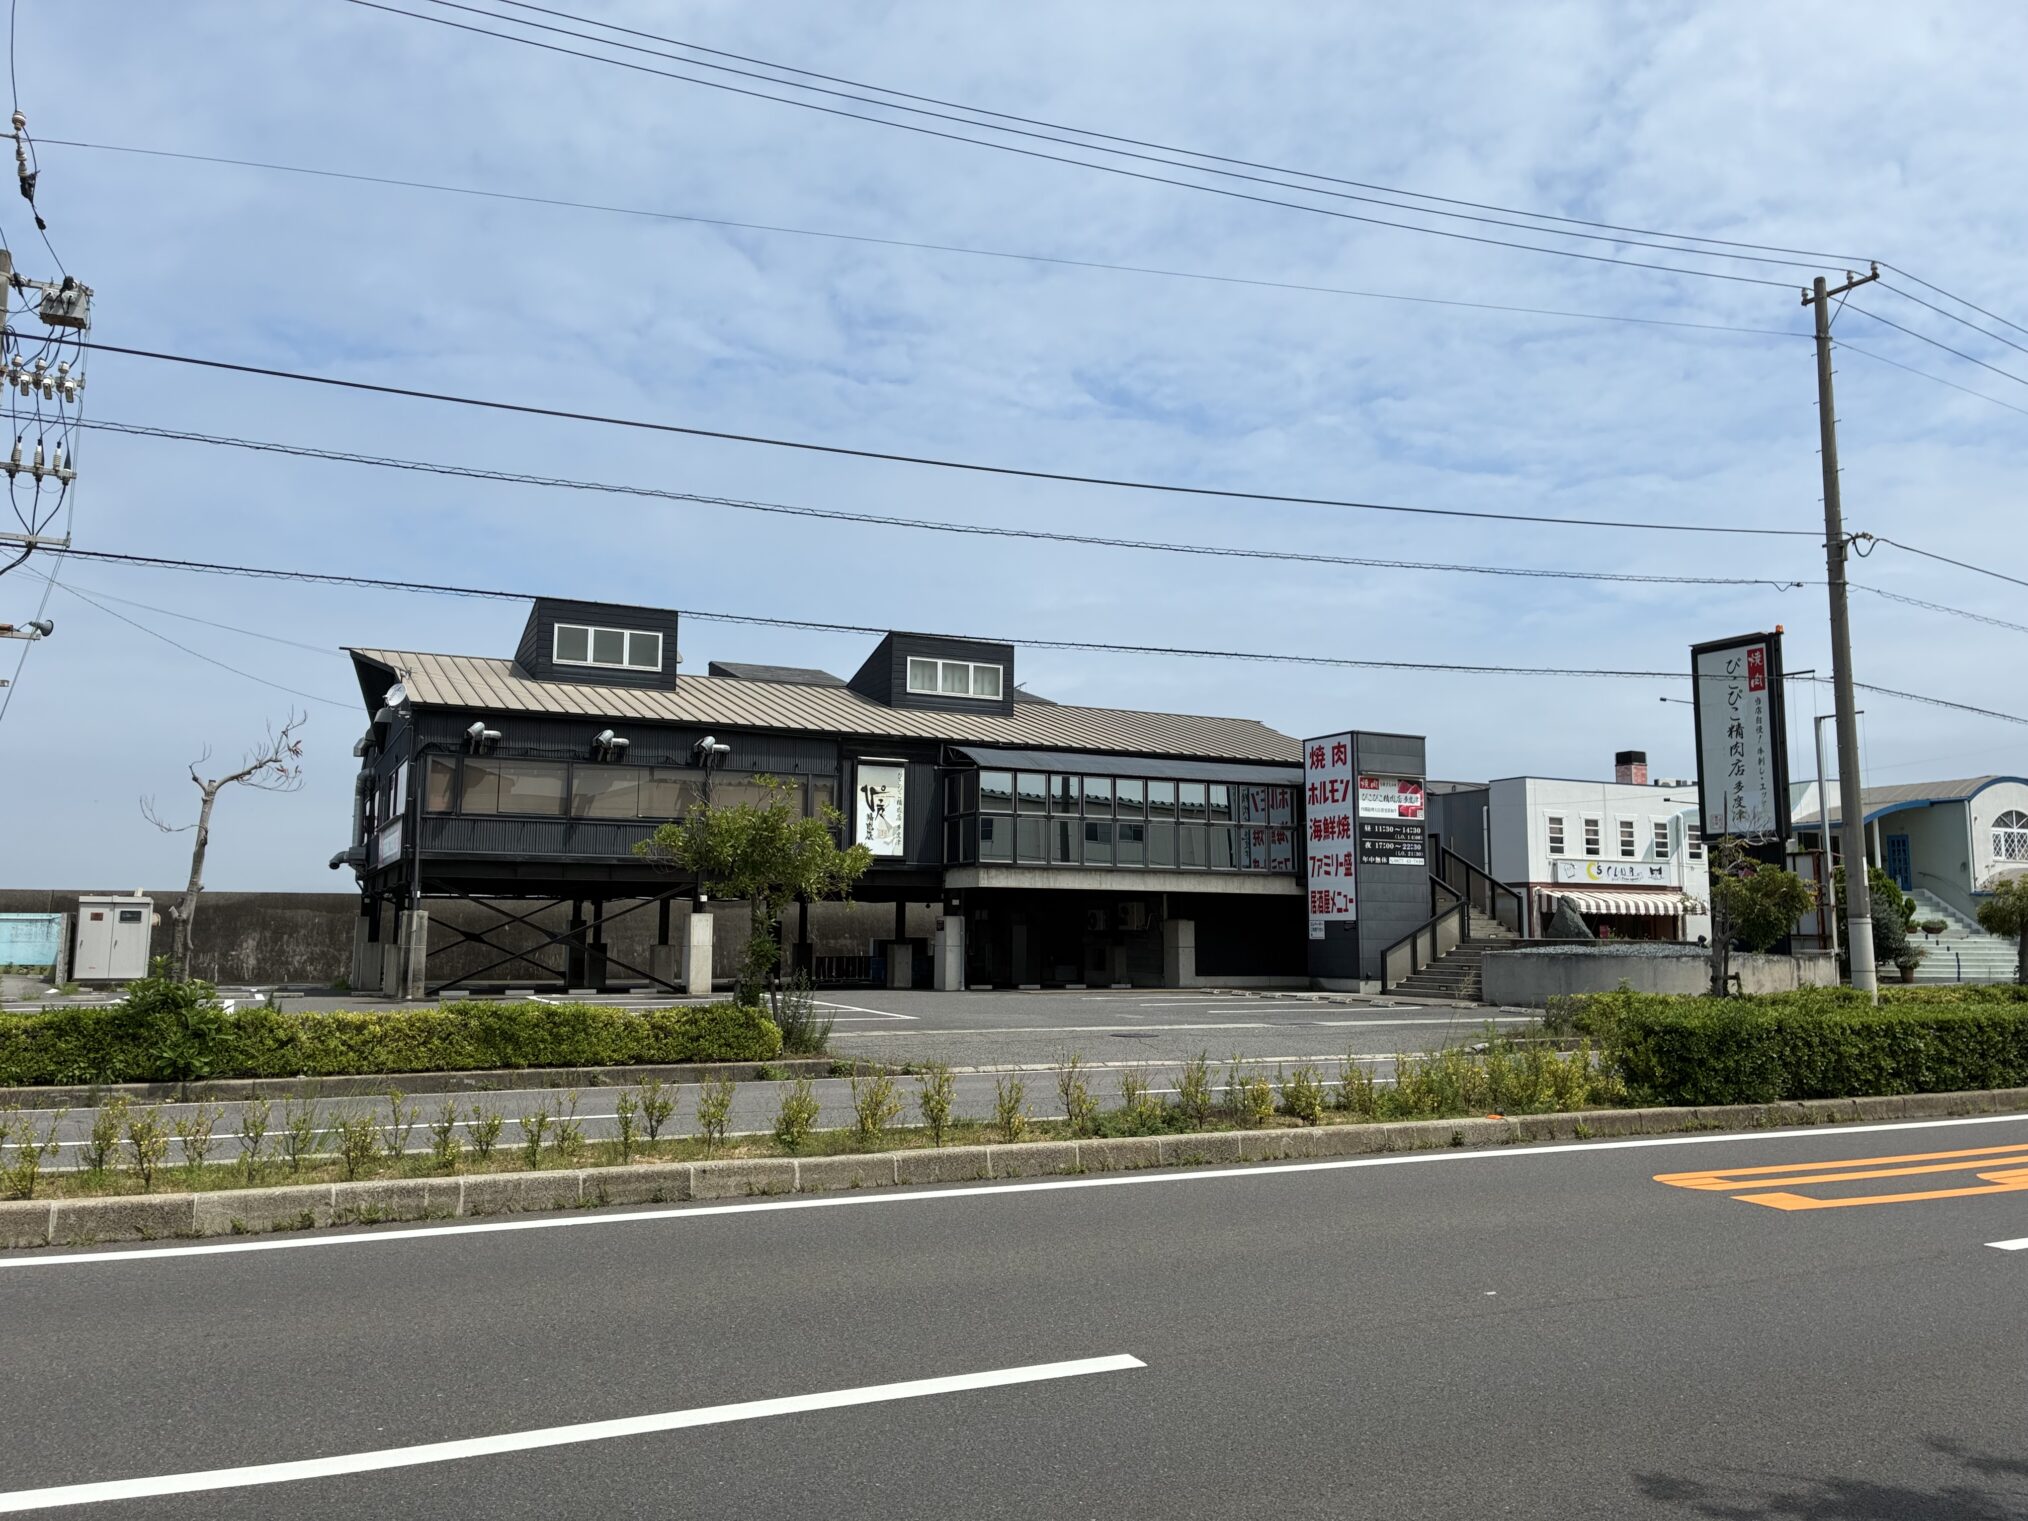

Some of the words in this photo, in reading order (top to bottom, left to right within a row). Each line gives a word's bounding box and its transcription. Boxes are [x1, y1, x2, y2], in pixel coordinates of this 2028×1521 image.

[1748, 651, 1763, 688] 焼肉
[1726, 657, 1746, 777] ぴこぴこ精肉店
[1309, 742, 1347, 770] 焼肉
[1308, 779, 1350, 805] ホルモン
[1309, 815, 1350, 841] 海鮮焼
[1309, 851, 1353, 878] ファミリー盛
[1311, 890, 1354, 914] 居酒屋メニュー
